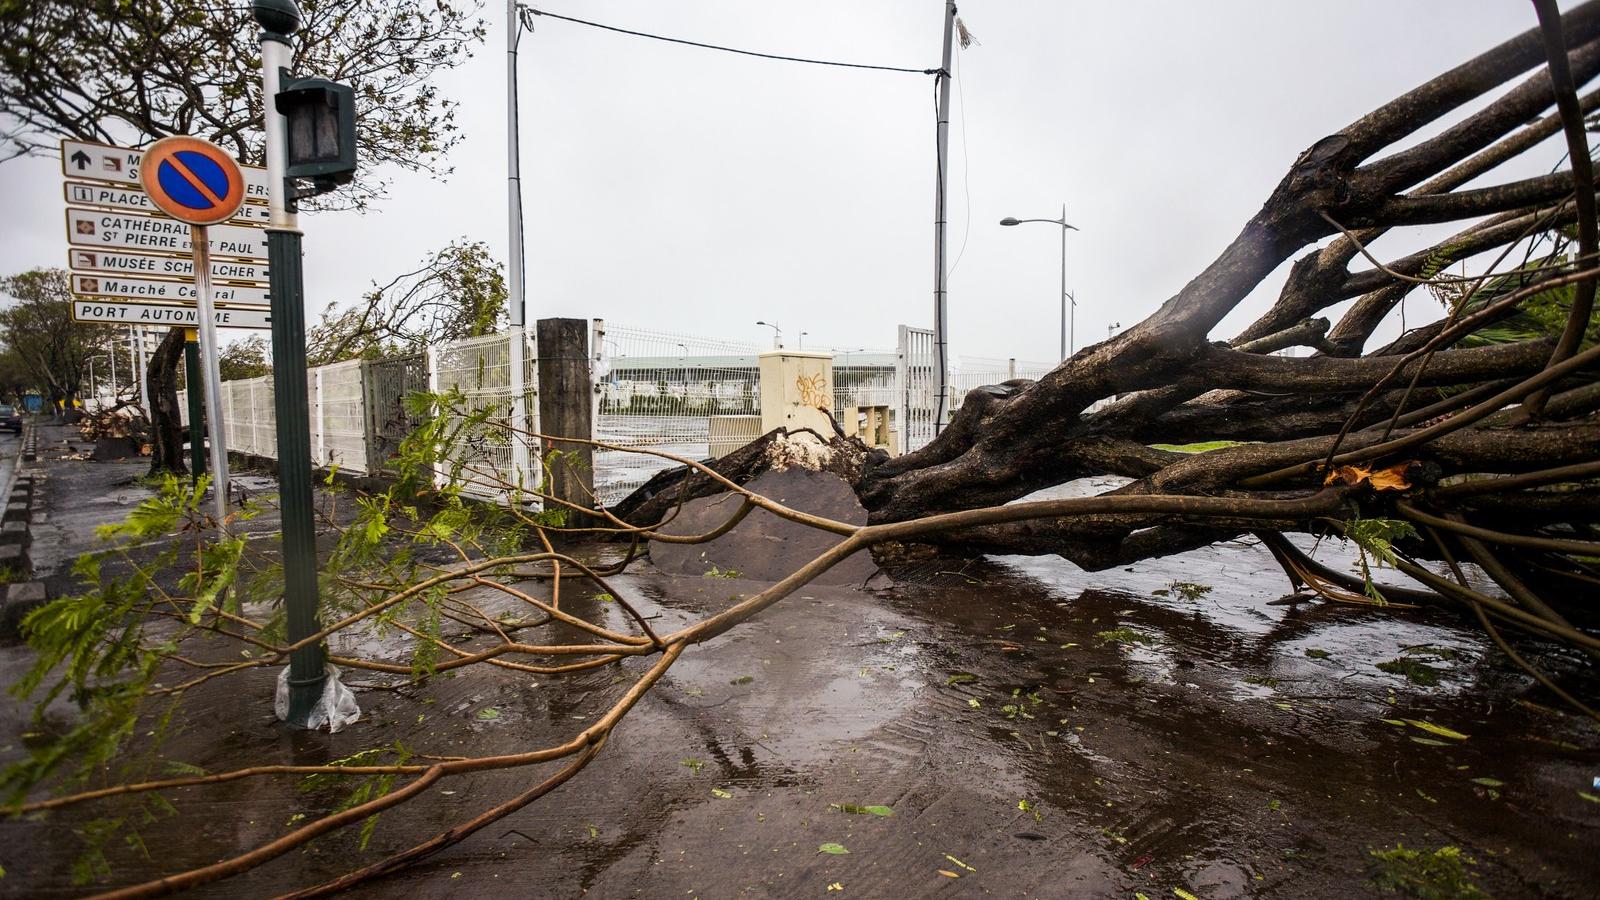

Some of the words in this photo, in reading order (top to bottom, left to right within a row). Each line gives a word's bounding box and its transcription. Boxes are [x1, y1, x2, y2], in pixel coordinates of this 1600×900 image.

[99, 191, 149, 206] PLACE
[101, 217, 190, 235] CATHÉDRAL
[125, 233, 177, 248] PIERRE
[220, 241, 254, 254] PAUL
[103, 257, 156, 270] MUSÉE
[164, 261, 255, 277] SCHLCHER
[104, 281, 166, 296] Marché
[178, 286, 235, 300] Ceral
[81, 305, 128, 318] PORT
[140, 309, 230, 323] AUTONE
